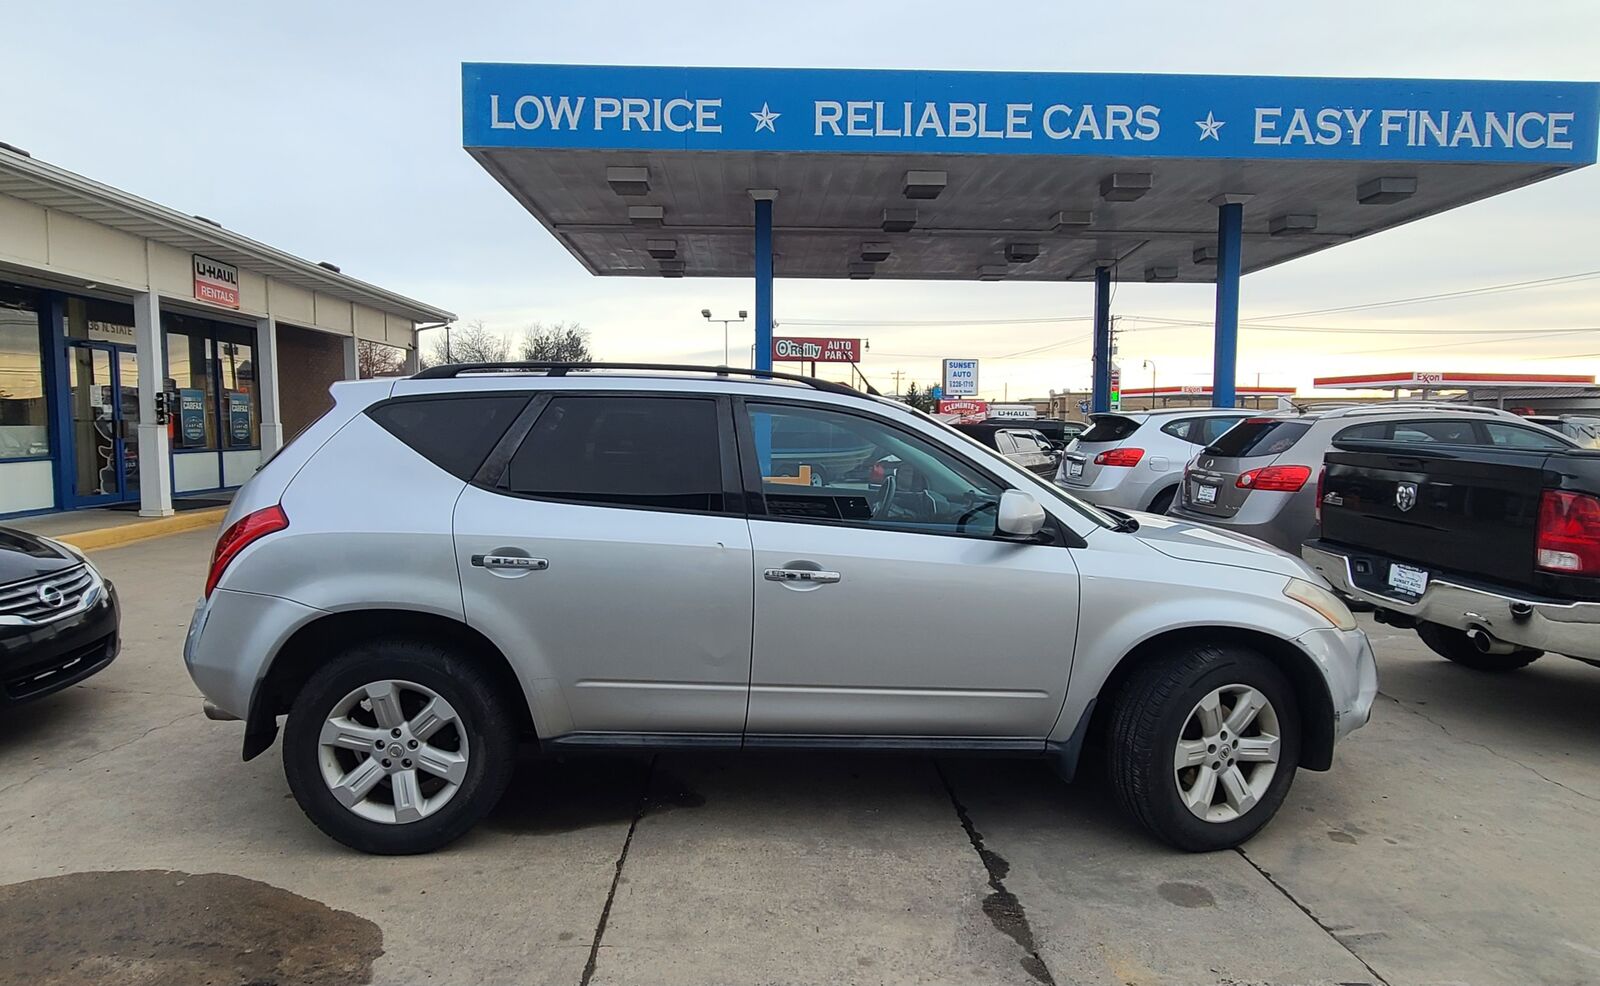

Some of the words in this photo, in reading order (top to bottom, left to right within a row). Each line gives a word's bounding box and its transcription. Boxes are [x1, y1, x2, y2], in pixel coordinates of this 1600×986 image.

[490, 94, 585, 131] LOW
[594, 96, 723, 134] PRICE
[814, 99, 1034, 140] RELIABLE
[1042, 103, 1161, 142] CARS
[1253, 106, 1373, 147] EASY
[1379, 109, 1575, 151] FINANCE
[196, 261, 237, 285] U-HAUL
[200, 285, 234, 303] RENTALS
[775, 339, 822, 359] O'Reilly
[827, 340, 852, 350] AUTO
[824, 350, 854, 360] PARTS
[948, 361, 976, 369] SUNSET
[952, 370, 972, 378] AUTO
[1416, 372, 1440, 384] Exxon
[183, 401, 203, 410] CARFAX
[944, 401, 981, 412] CLEMENTE'S
